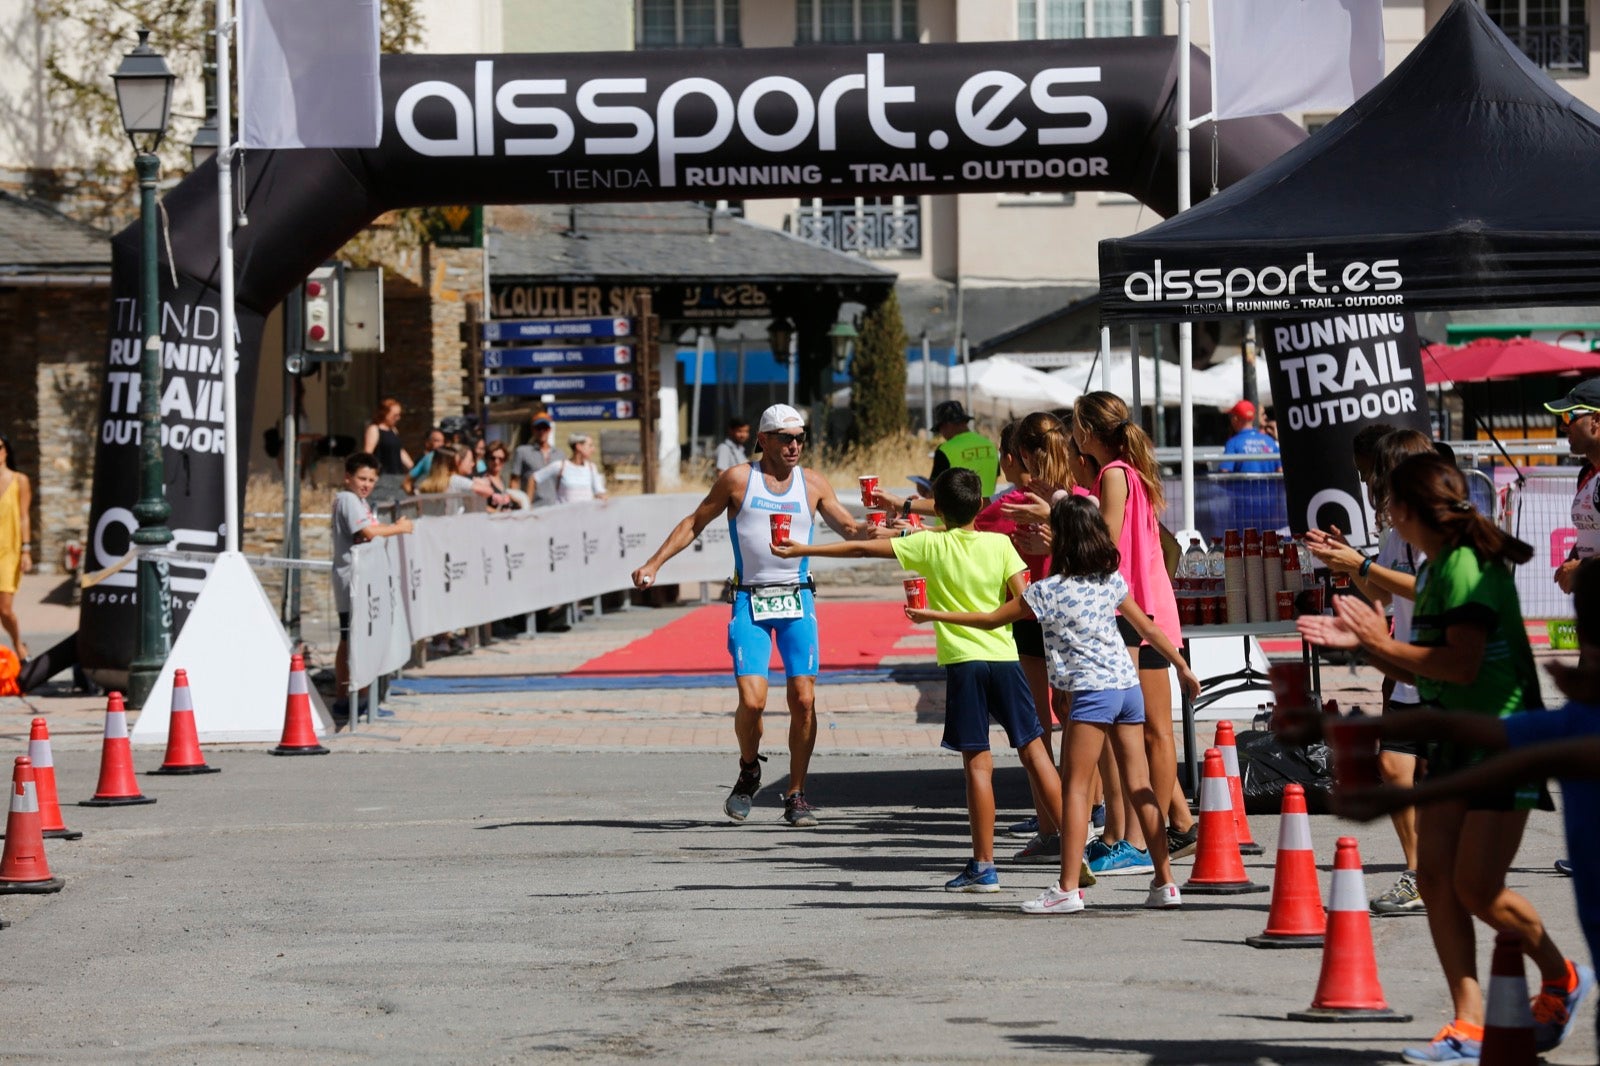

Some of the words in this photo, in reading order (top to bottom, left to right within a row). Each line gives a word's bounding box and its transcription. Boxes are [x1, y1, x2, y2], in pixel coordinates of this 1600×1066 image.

[394, 53, 1109, 187] alssport.es
[548, 169, 652, 189] TIENDA
[686, 165, 822, 187] RUNNING
[849, 162, 936, 183] TRAIL
[962, 157, 1109, 180] OUTDOOR
[1124, 252, 1403, 312] alssport.es
[1183, 303, 1224, 315] TIENDA
[1236, 300, 1291, 312] RUNNING
[1301, 298, 1336, 309] TRAIL
[1344, 294, 1404, 307] OUTDOOR
[1274, 312, 1405, 354] RUNNING
[1280, 340, 1413, 399] TRAIL
[1288, 387, 1417, 430] OUTDOOR
[90, 592, 138, 605] sport
[758, 596, 798, 612] 130
